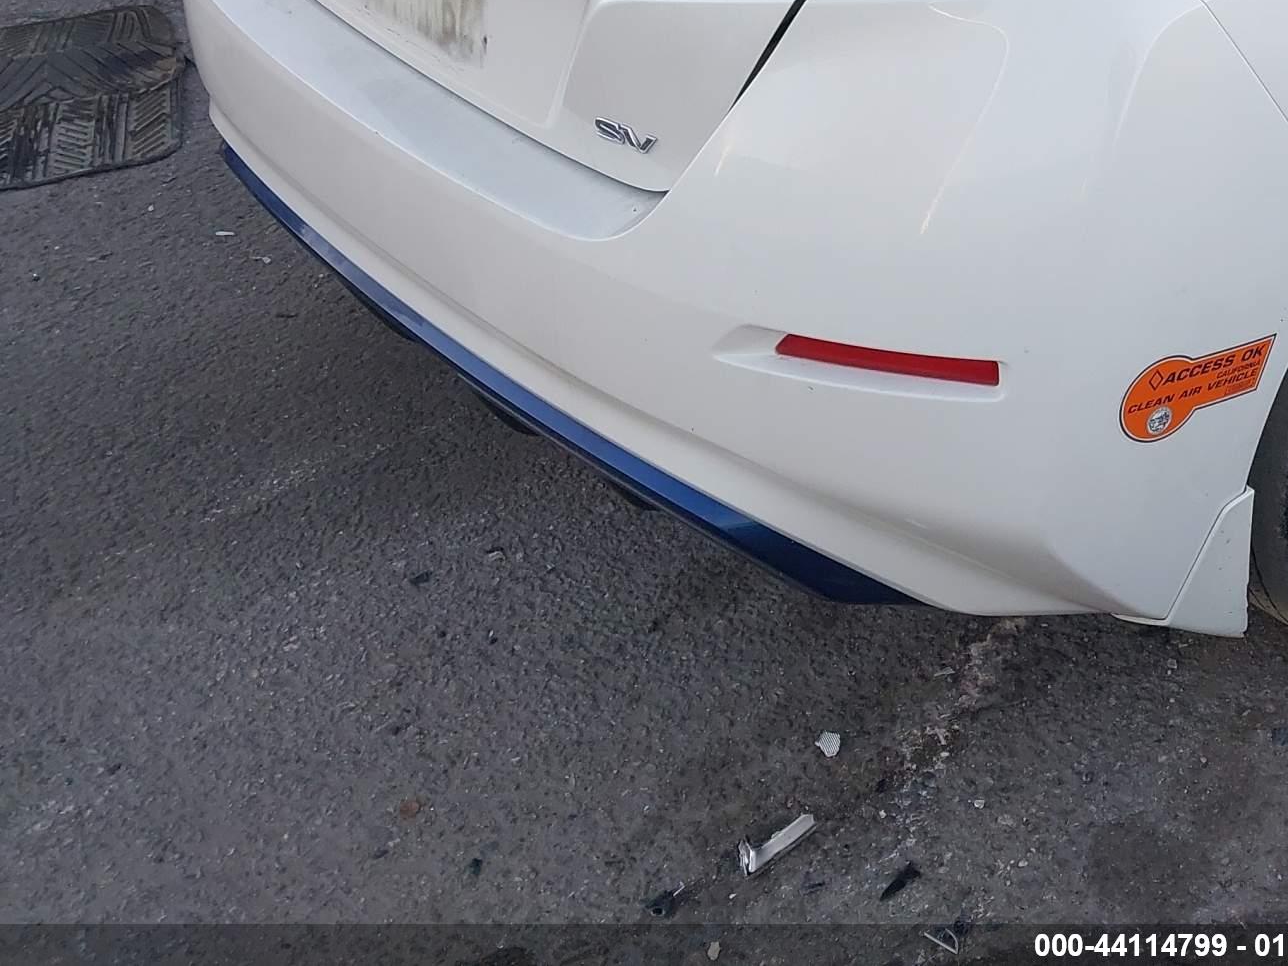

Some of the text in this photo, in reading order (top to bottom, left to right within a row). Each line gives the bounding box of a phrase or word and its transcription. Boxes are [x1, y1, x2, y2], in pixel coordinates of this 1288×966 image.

[595, 117, 658, 154] SV
[1162, 355, 1236, 387] ACCESS
[1240, 344, 1266, 362] OK
[1127, 393, 1175, 414] CLEAN
[1178, 386, 1203, 400] AIR
[1207, 367, 1258, 391] VEHICLE
